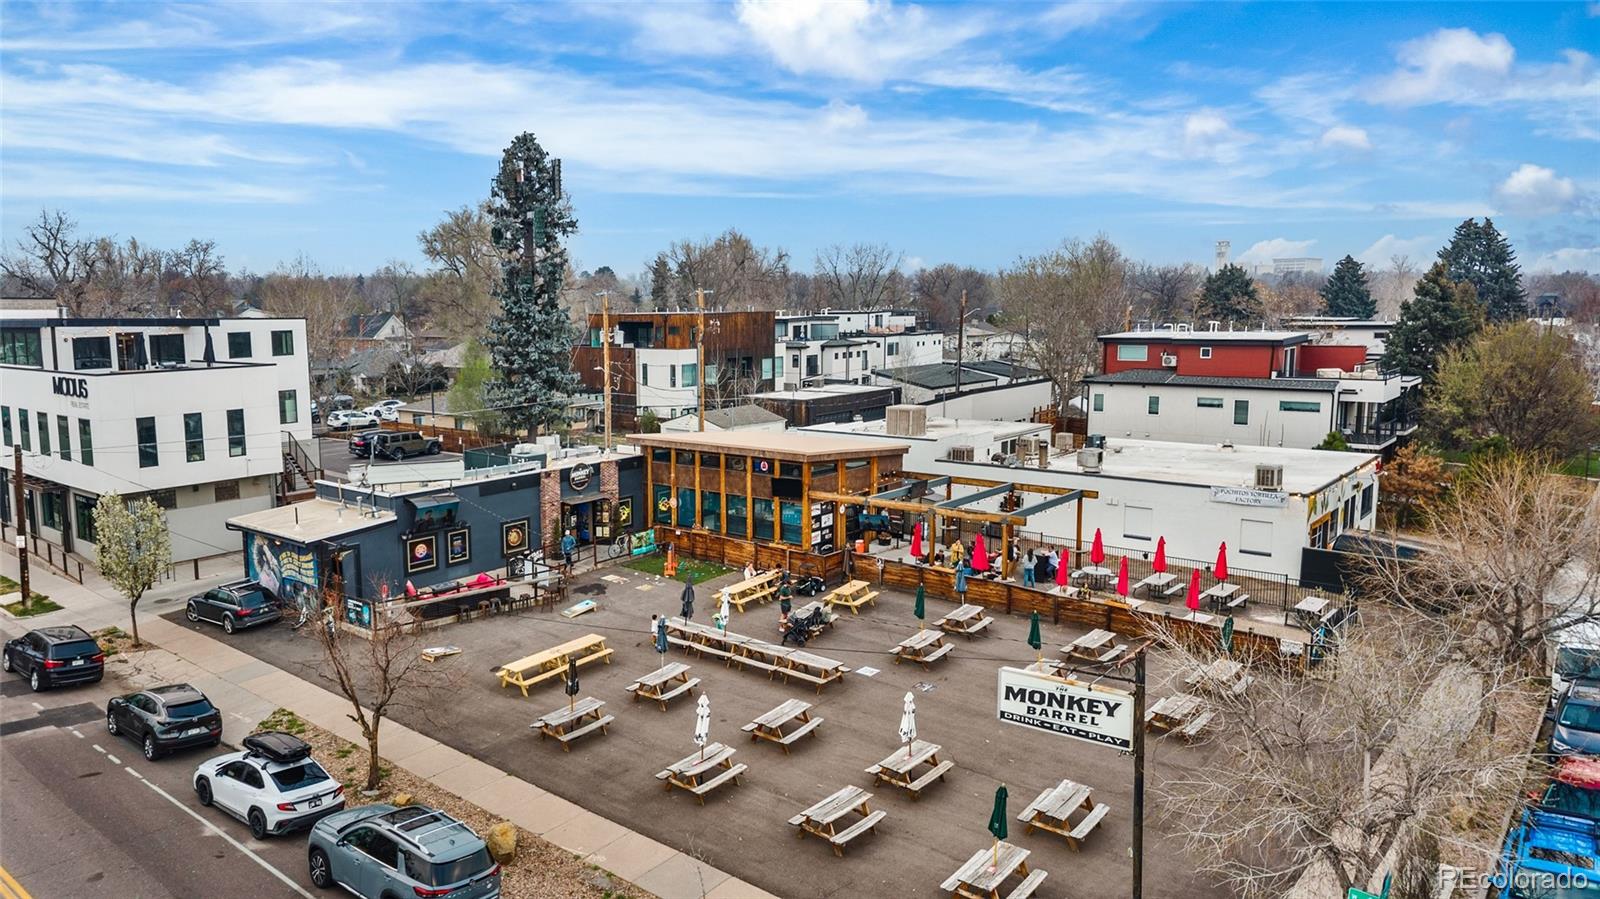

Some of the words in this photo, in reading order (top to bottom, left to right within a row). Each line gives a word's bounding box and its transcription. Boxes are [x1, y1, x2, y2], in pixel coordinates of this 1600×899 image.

[52, 376, 88, 399] MODUS
[1004, 685, 1122, 717] MONKEY
[1026, 705, 1099, 726] BARREL
